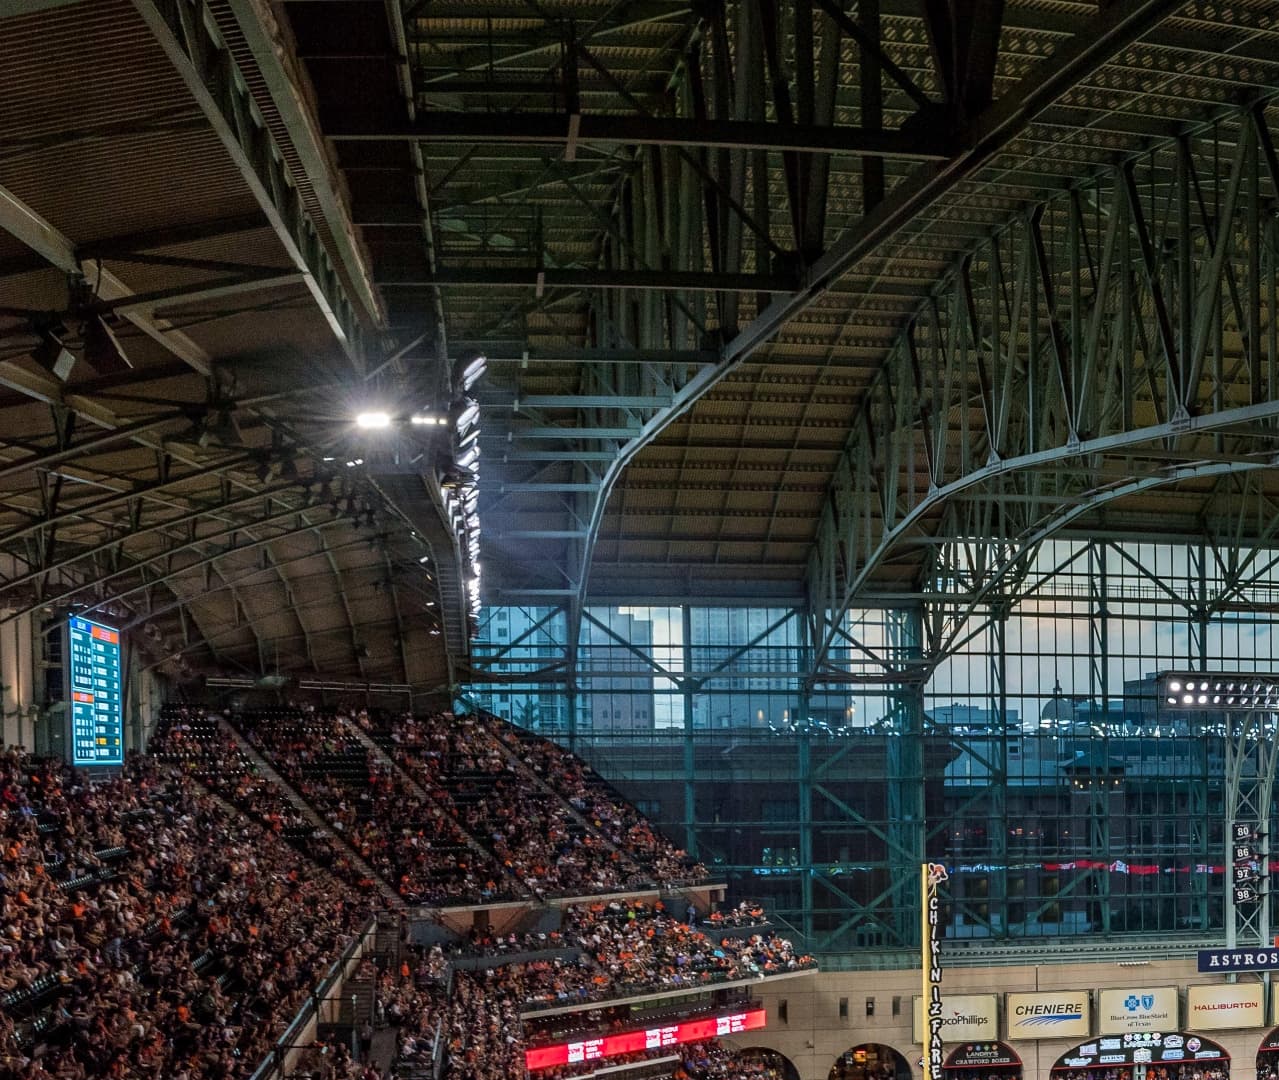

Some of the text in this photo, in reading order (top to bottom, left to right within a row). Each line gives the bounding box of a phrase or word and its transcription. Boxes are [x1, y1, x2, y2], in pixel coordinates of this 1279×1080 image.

[1237, 827, 1249, 836] 80
[1237, 848, 1249, 857] 86
[1237, 870, 1249, 878] 97
[1237, 890, 1250, 899] 98
[929, 896, 942, 983] CHIKIN
[1015, 1003, 1084, 1015] CHENIERE
[1193, 1002, 1259, 1011] HALLIBURTON
[941, 1013, 989, 1027] ocoPhillips
[930, 1018, 943, 1080] FARE
